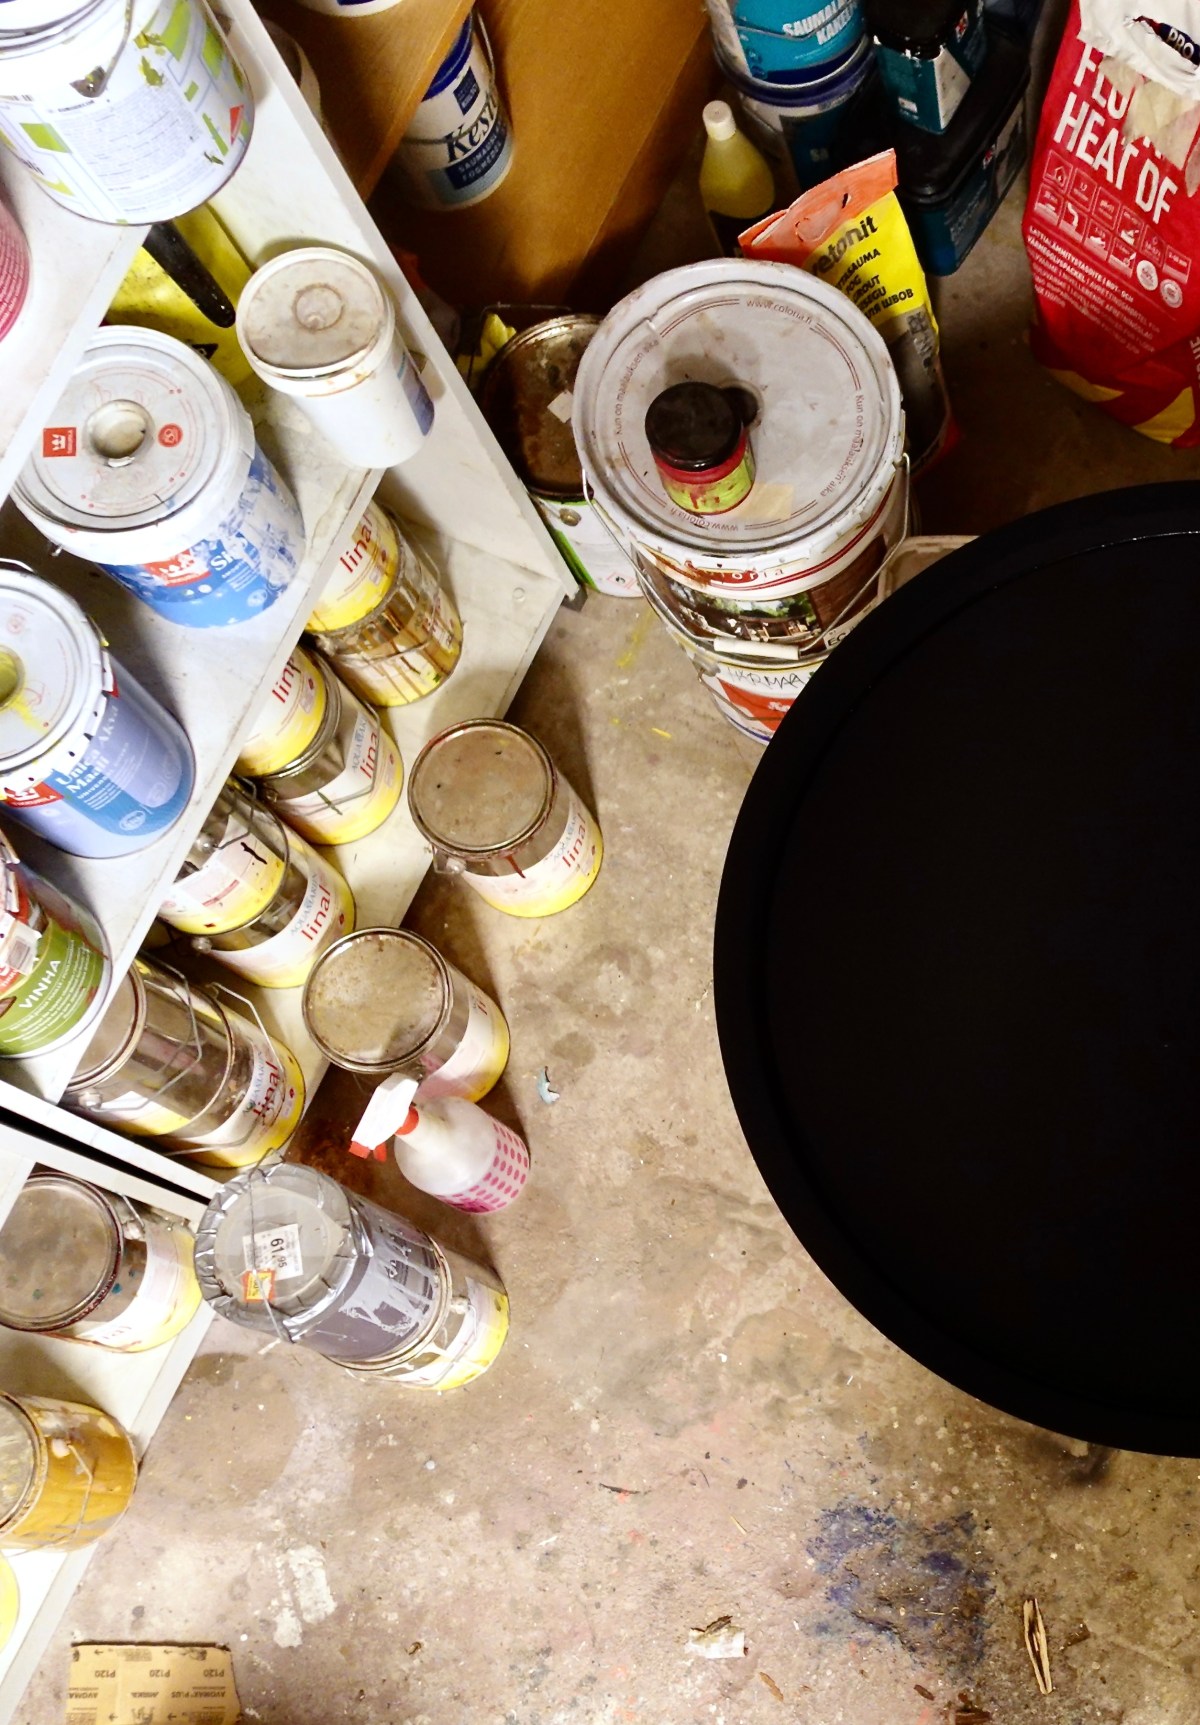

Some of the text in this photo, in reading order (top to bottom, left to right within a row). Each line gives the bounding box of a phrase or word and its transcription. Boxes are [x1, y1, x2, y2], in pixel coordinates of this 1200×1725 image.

[1168, 28, 1195, 61] PRO
[1053, 92, 1140, 190] HEAT
[1135, 159, 1178, 225] DF
[883, 288, 914, 310] ШВОВ
[56, 748, 101, 785] Unica
[66, 755, 110, 794] Maali
[301, 883, 331, 941] linal
[19, 959, 61, 1009] VINHA
[95, 1669, 116, 1678] P120
[149, 1669, 171, 1678] P120
[203, 1669, 225, 1677] P120
